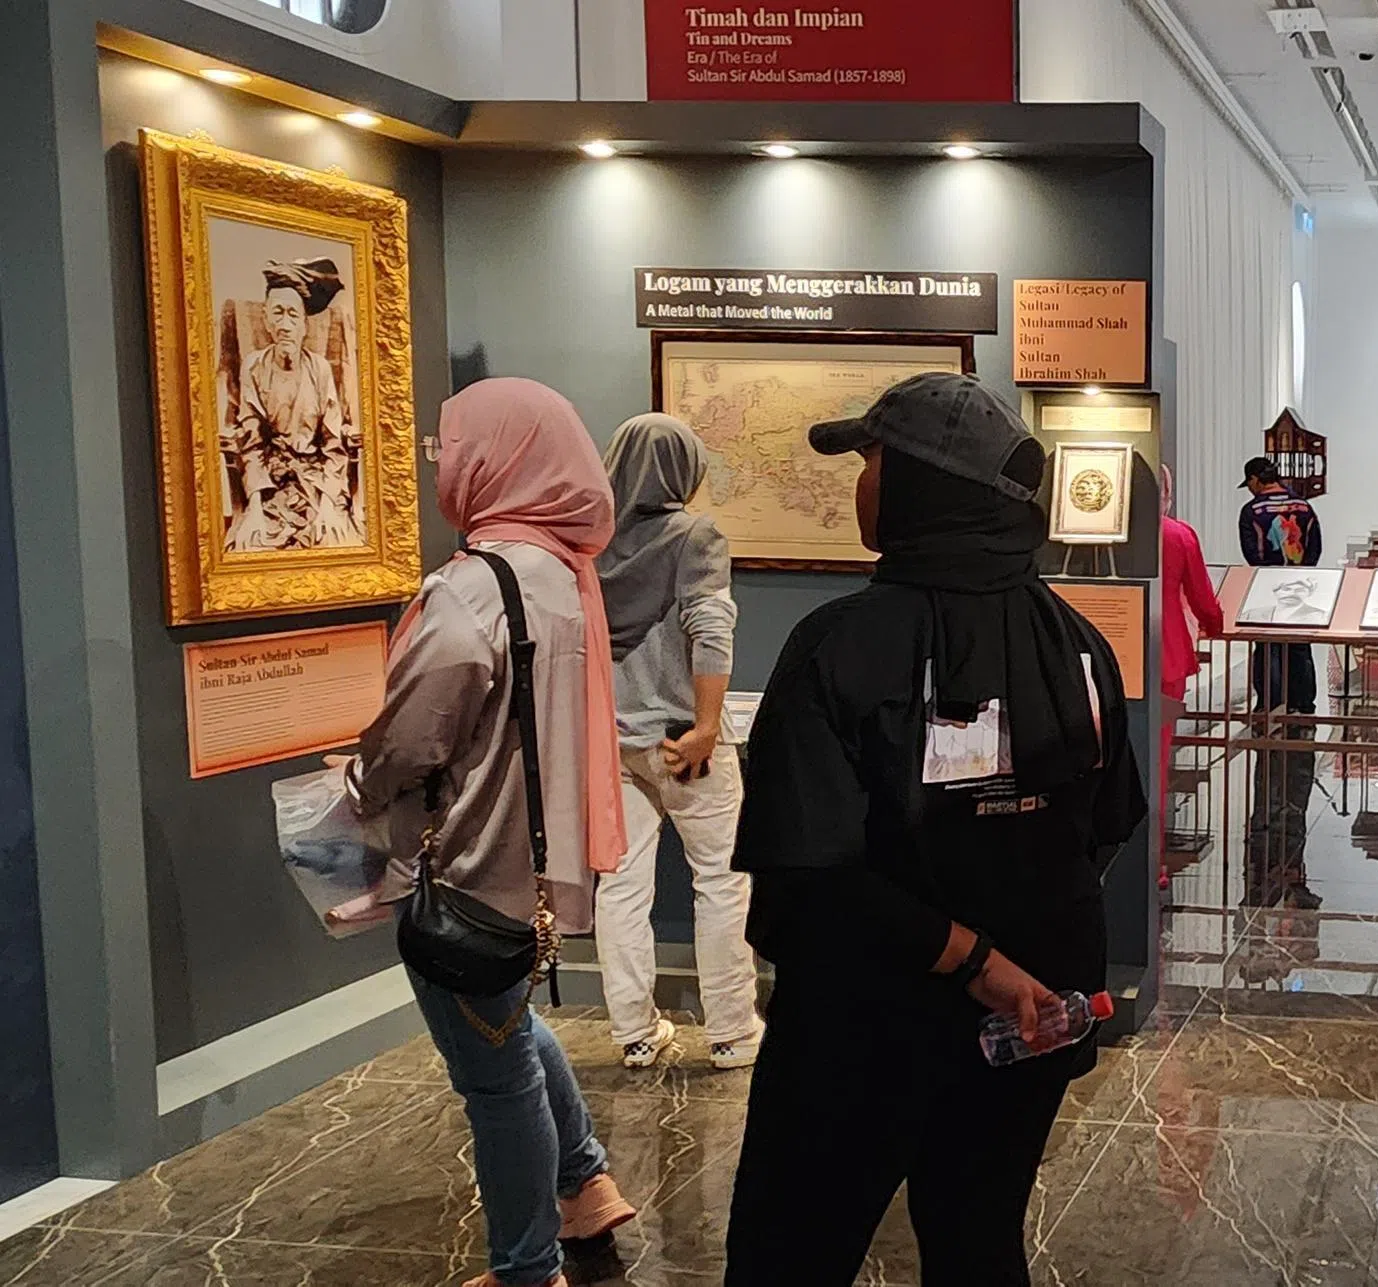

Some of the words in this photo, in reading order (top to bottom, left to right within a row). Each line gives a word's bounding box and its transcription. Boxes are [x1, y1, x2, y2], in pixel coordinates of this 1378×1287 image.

[685, 7, 749, 28] Timah
[753, 7, 789, 27] dan
[794, 7, 864, 31] Impian
[685, 31, 710, 46] Tin
[712, 31, 737, 46] and
[740, 32, 793, 46] Dreams
[687, 51, 708, 64] Era
[717, 51, 741, 64] The
[743, 51, 763, 64] Era
[765, 51, 778, 64] of
[687, 69, 728, 83] Sultan
[729, 69, 746, 83] Sir
[750, 69, 786, 83] Abdul
[787, 69, 831, 83] Samad
[834, 69, 906, 84] (1857-1898)
[644, 272, 712, 296] Logam
[713, 277, 762, 297] yang
[766, 274, 914, 298] Menggerakkan
[918, 277, 981, 297] Dunia
[1112, 283, 1126, 295] of
[645, 304, 657, 317] A
[657, 304, 694, 318] Metal
[696, 304, 723, 318] that
[725, 305, 768, 319] Moved
[770, 306, 792, 320] the
[793, 306, 833, 321] World
[1019, 300, 1059, 311] Sultan
[1019, 316, 1093, 329] Muhammad
[1096, 317, 1128, 329] Shah
[1019, 333, 1044, 345] ibni
[1019, 351, 1060, 363] Sultan
[1019, 367, 1071, 379] Ibrahim
[1075, 368, 1107, 380] Shah
[198, 657, 237, 673] Sultan
[240, 655, 258, 667] Sir
[200, 675, 224, 690] ibni
[255, 663, 304, 681] Abdullah
